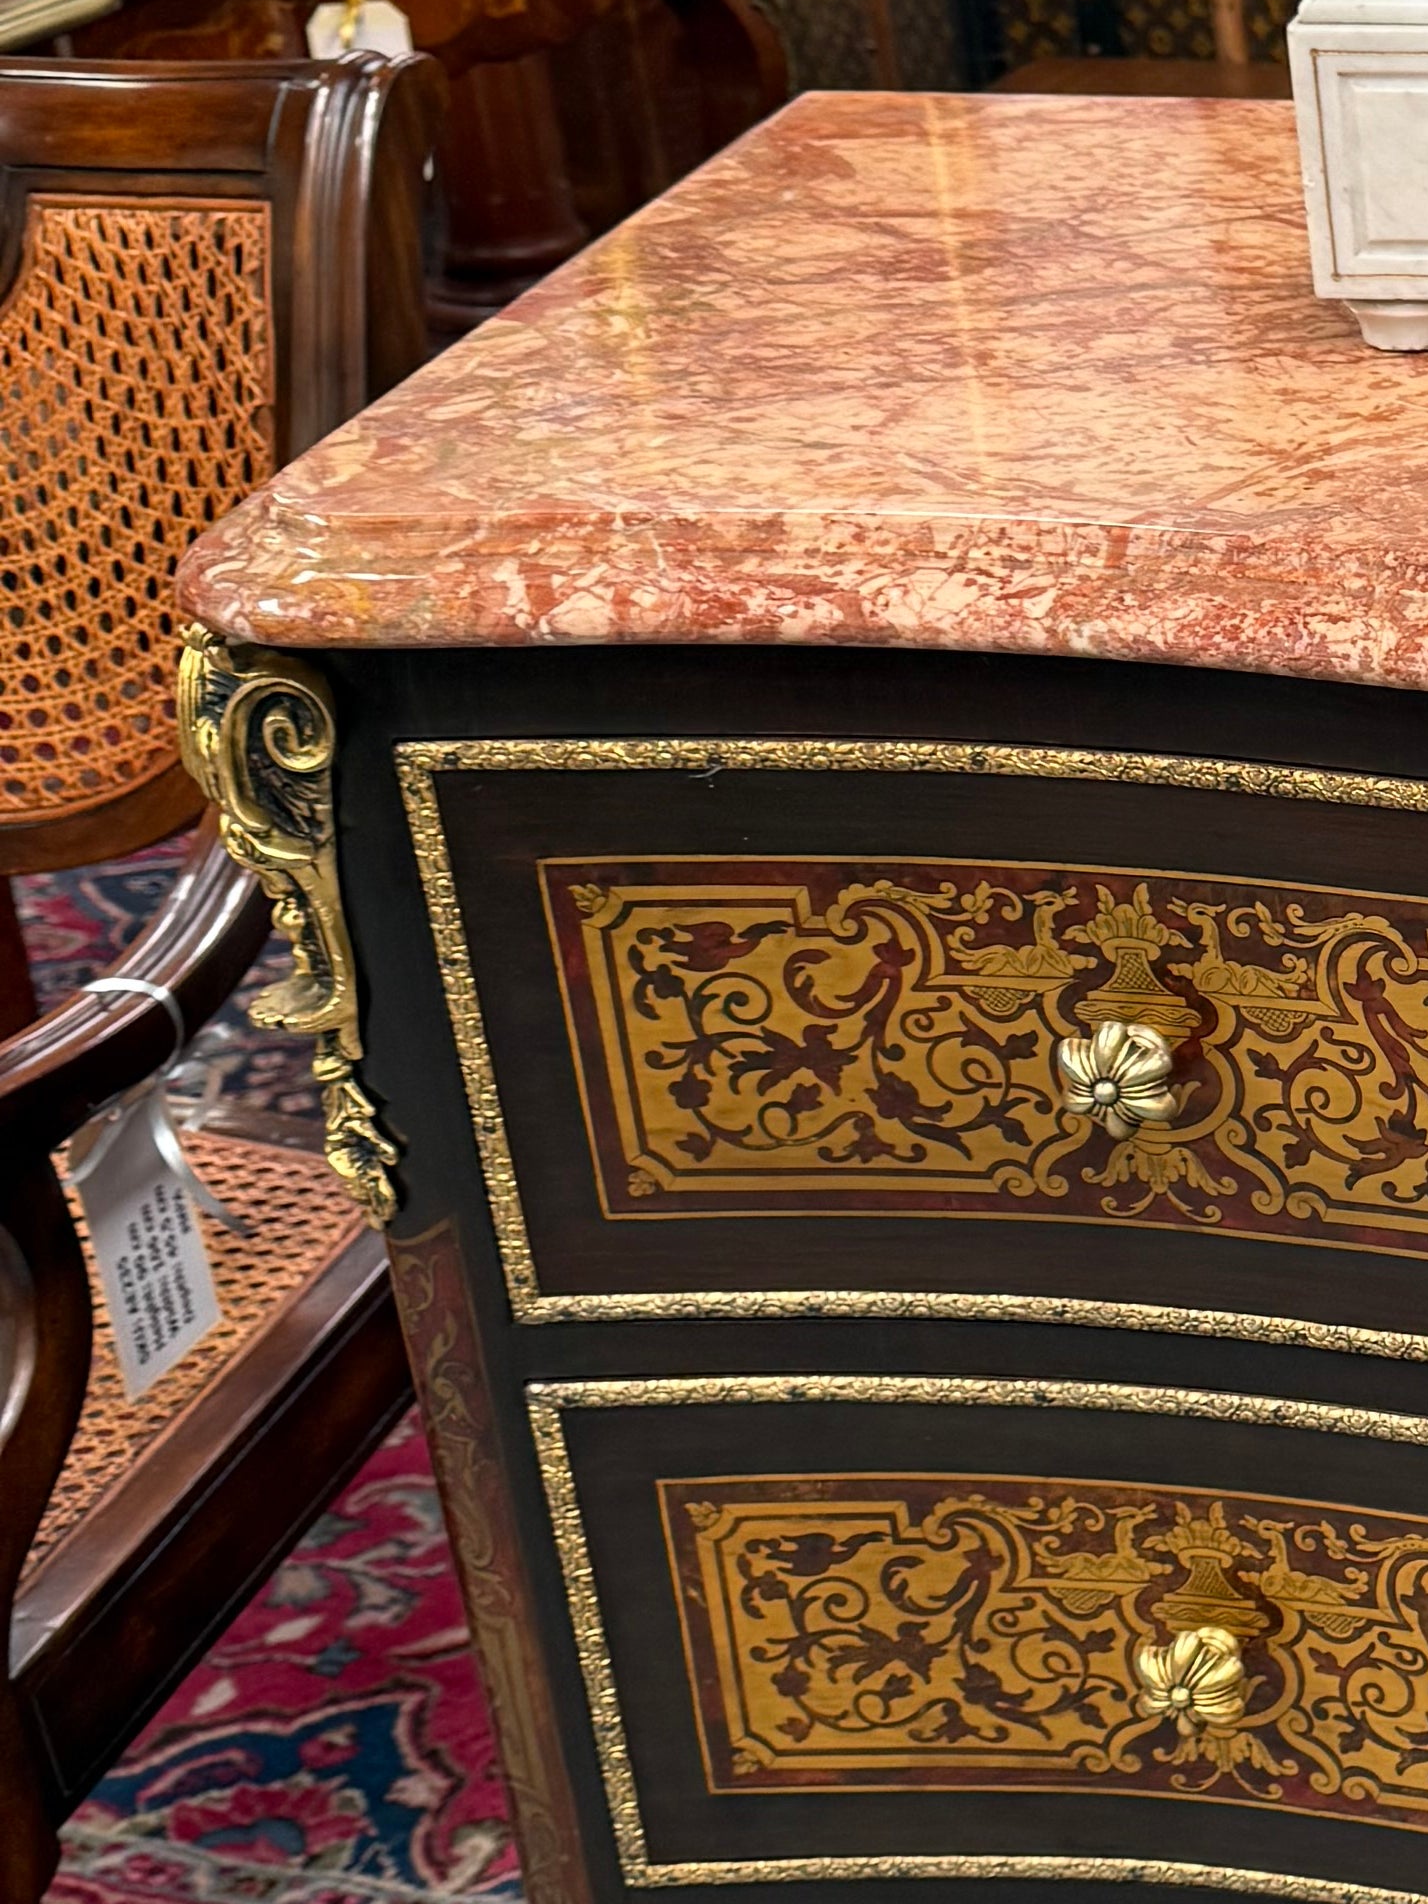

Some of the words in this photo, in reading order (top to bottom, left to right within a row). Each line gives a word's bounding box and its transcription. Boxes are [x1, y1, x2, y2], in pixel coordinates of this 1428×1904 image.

[154, 1184, 167, 1212] cm
[141, 1202, 154, 1231] cm
[128, 1221, 140, 1250] cm
[143, 1283, 165, 1351] Height:
[159, 1276, 179, 1338] Width:
